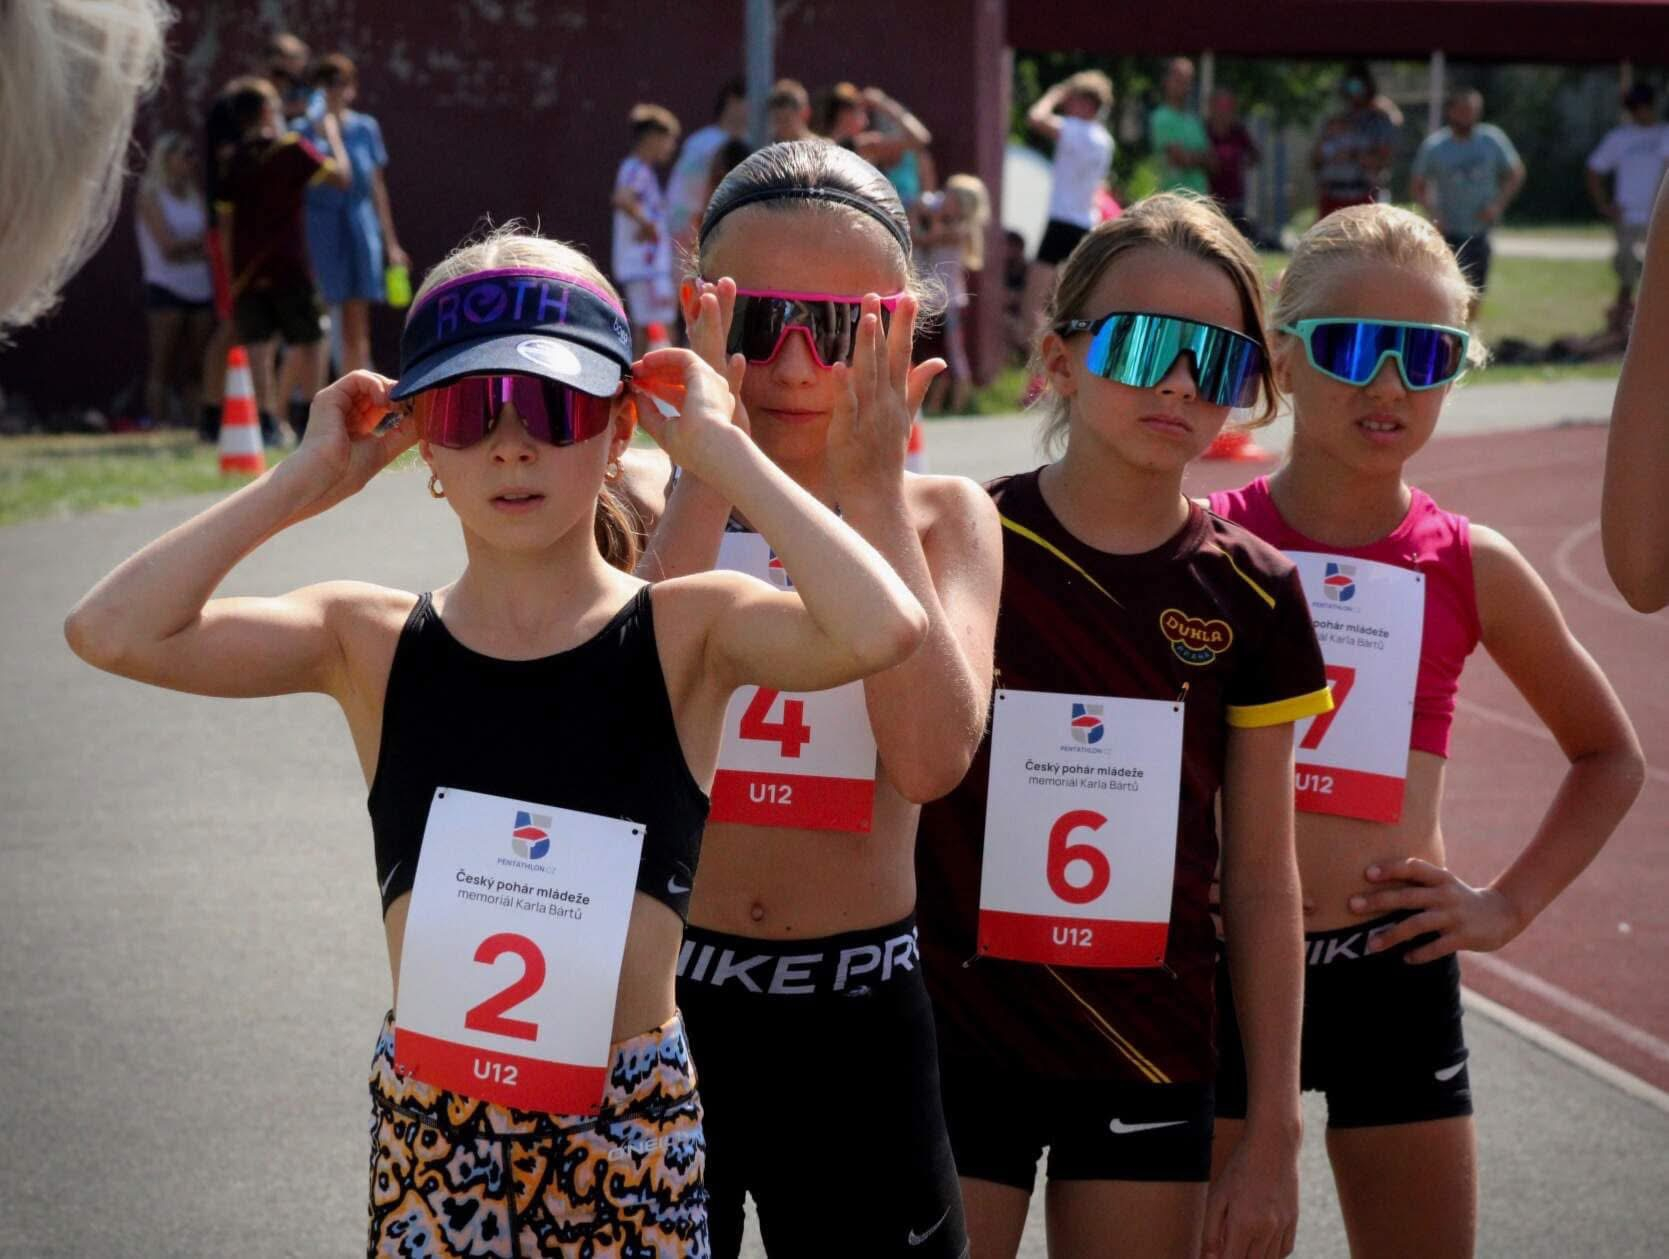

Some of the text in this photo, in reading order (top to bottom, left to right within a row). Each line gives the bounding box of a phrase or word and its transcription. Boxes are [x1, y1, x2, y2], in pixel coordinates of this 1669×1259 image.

[437, 280, 570, 339] ROTH
[1166, 616, 1223, 642] DUKLA
[1300, 664, 1356, 750] 7
[740, 686, 811, 758] 4
[1025, 759, 1144, 778] Český pohár mládeže
[1028, 776, 1078, 788] memoriál
[1081, 779, 1107, 790] Karla
[749, 784, 792, 804] U12
[1295, 773, 1334, 794] U12
[1046, 809, 1111, 905] 6
[456, 868, 590, 905] Český pohár mládeže
[457, 889, 582, 921] memoriál Karla Bártů
[1053, 927, 1093, 946] U12
[464, 932, 547, 1042] 2
[473, 1059, 519, 1086] U12
